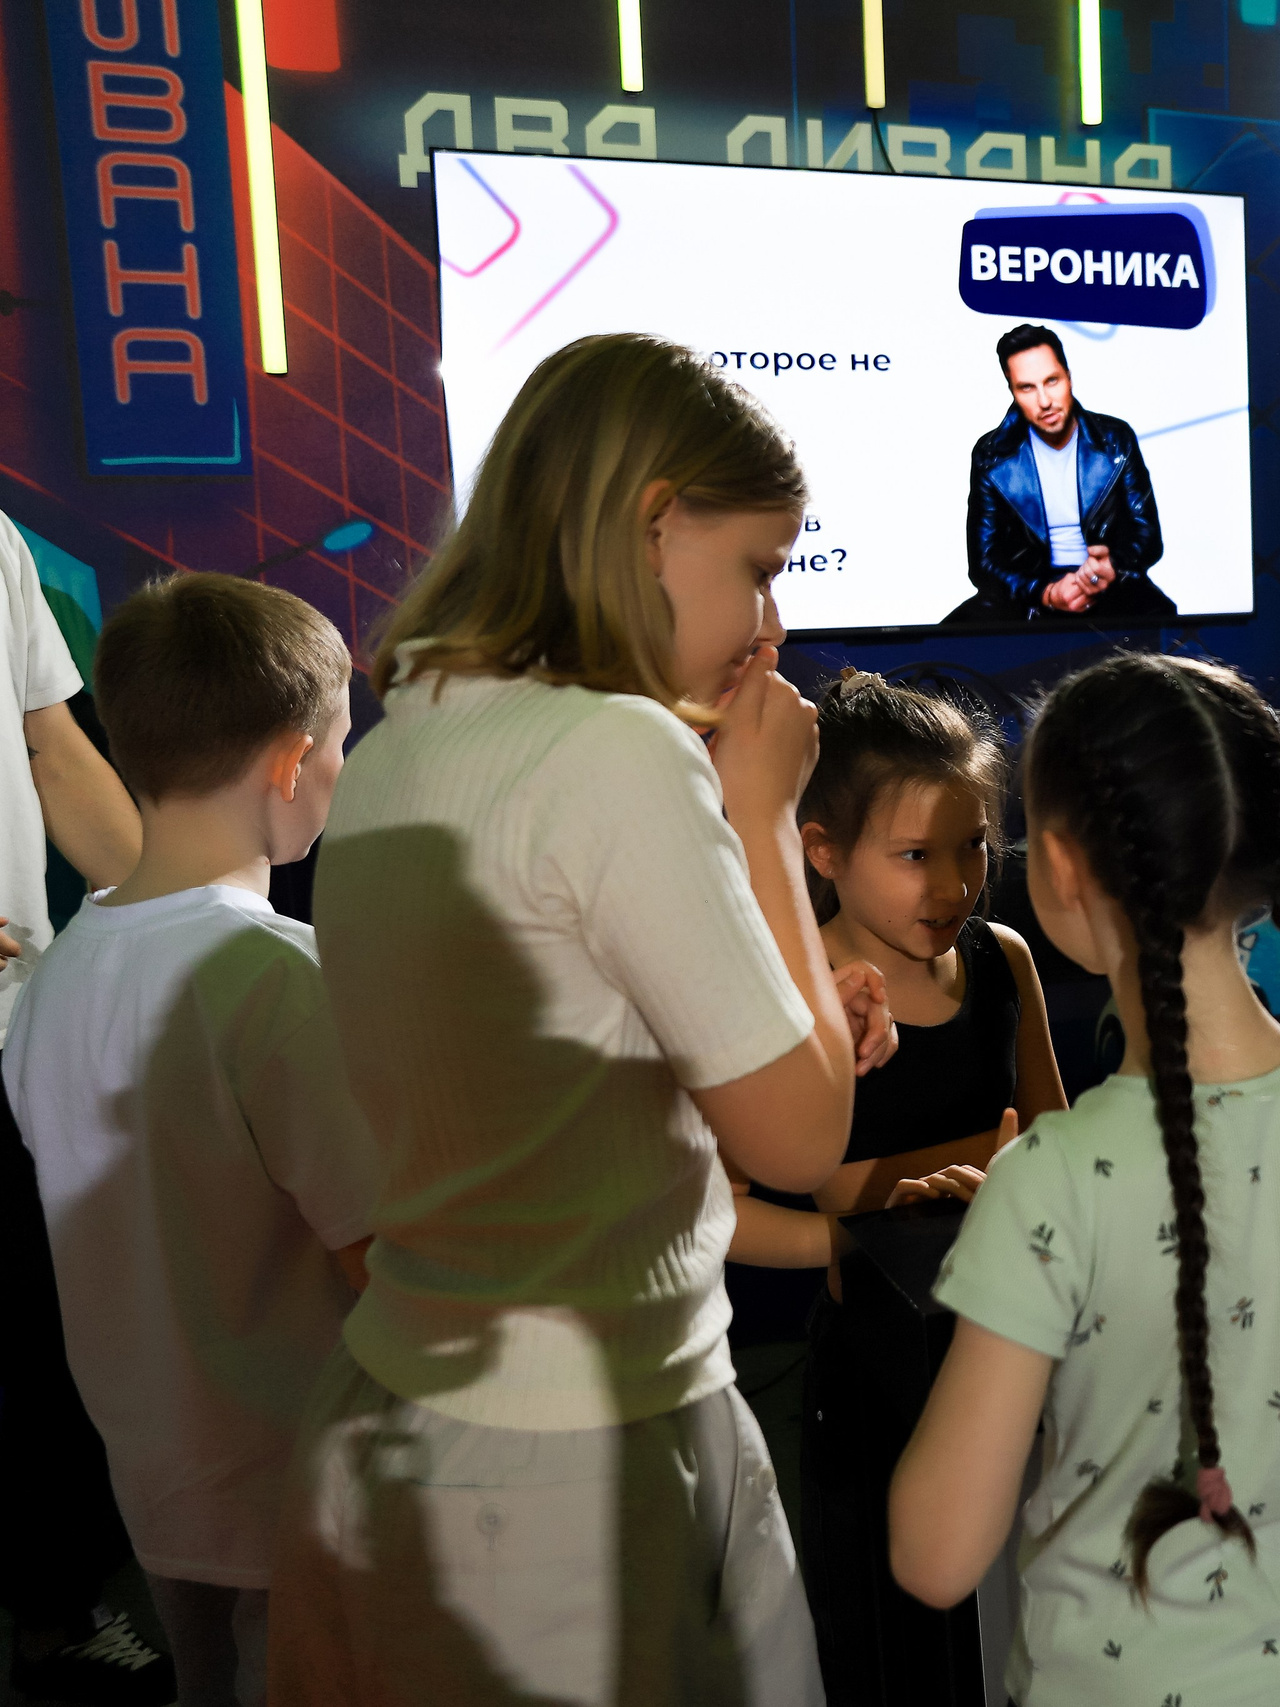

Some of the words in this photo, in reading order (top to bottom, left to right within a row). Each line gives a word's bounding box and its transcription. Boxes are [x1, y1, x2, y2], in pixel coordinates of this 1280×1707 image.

[970, 244, 1200, 288] ВЕРОНИКА
[708, 350, 837, 377] оторое
[851, 353, 891, 372] не
[787, 548, 847, 573] не?
